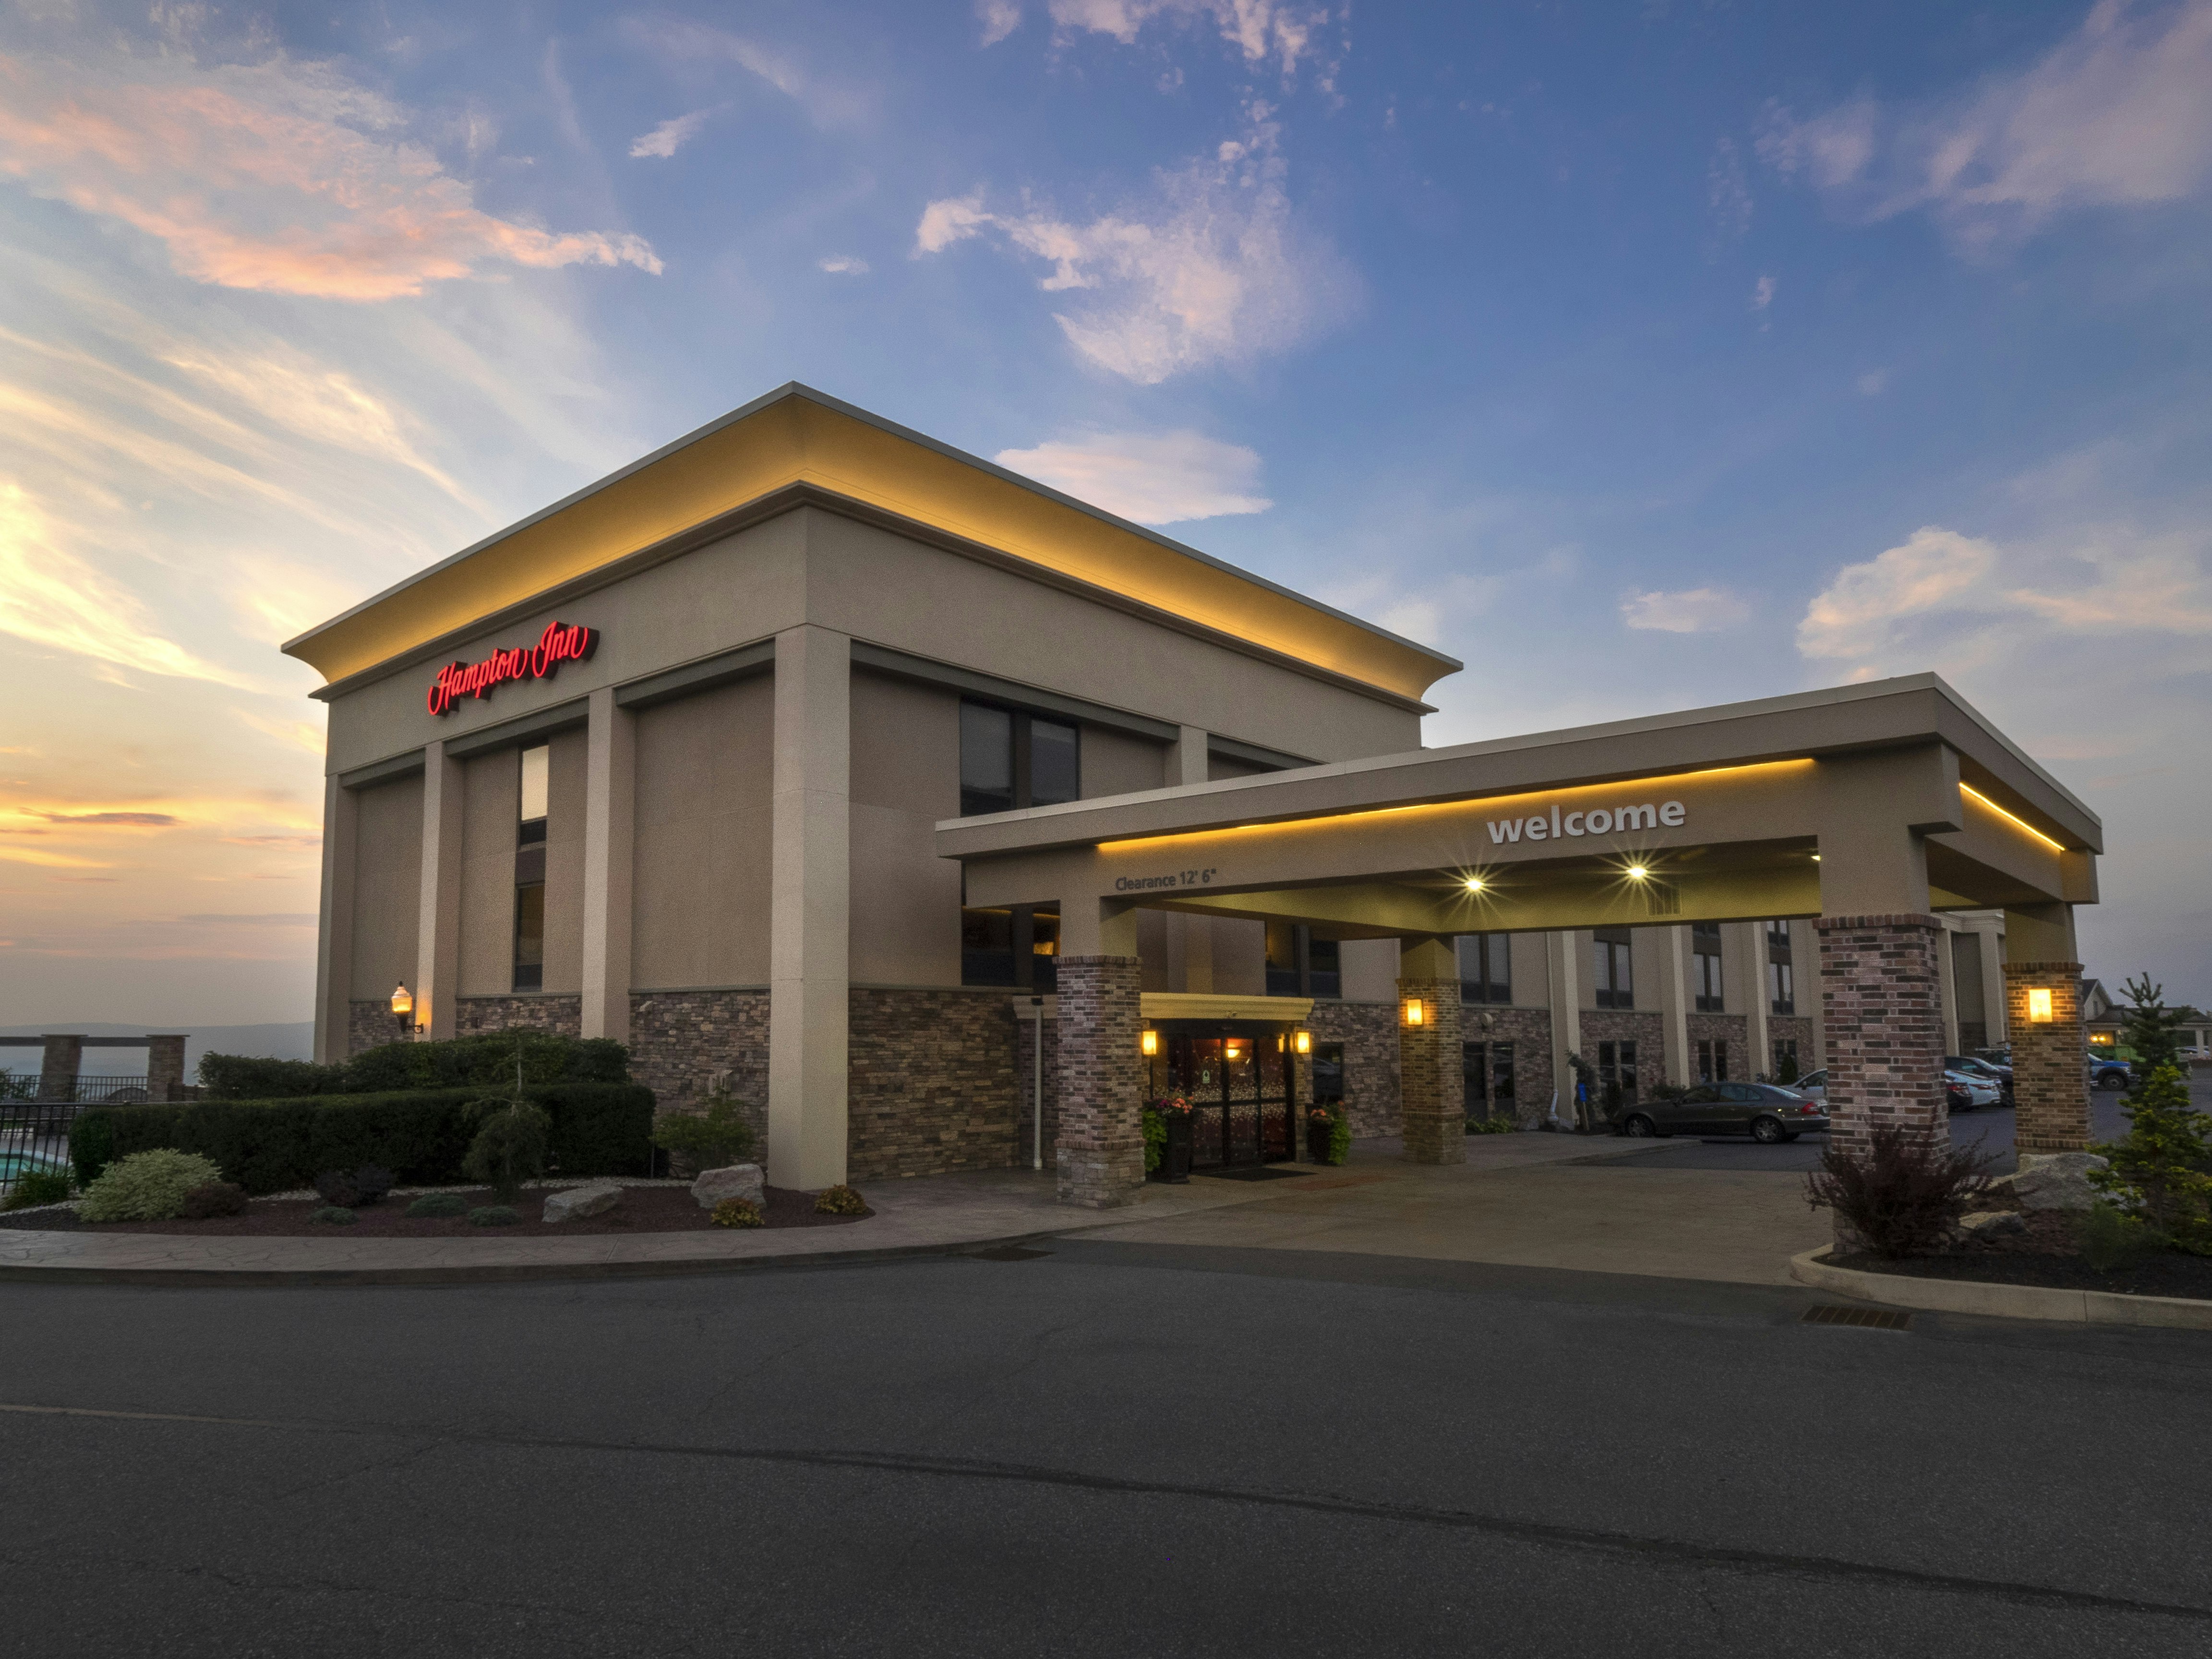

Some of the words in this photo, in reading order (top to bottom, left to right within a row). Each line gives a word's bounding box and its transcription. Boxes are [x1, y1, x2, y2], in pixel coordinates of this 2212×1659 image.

[427, 647, 528, 715] Hampton
[532, 621, 589, 678] Inn
[1487, 800, 1686, 844] welcome
[1115, 876, 1176, 891] Clearance
